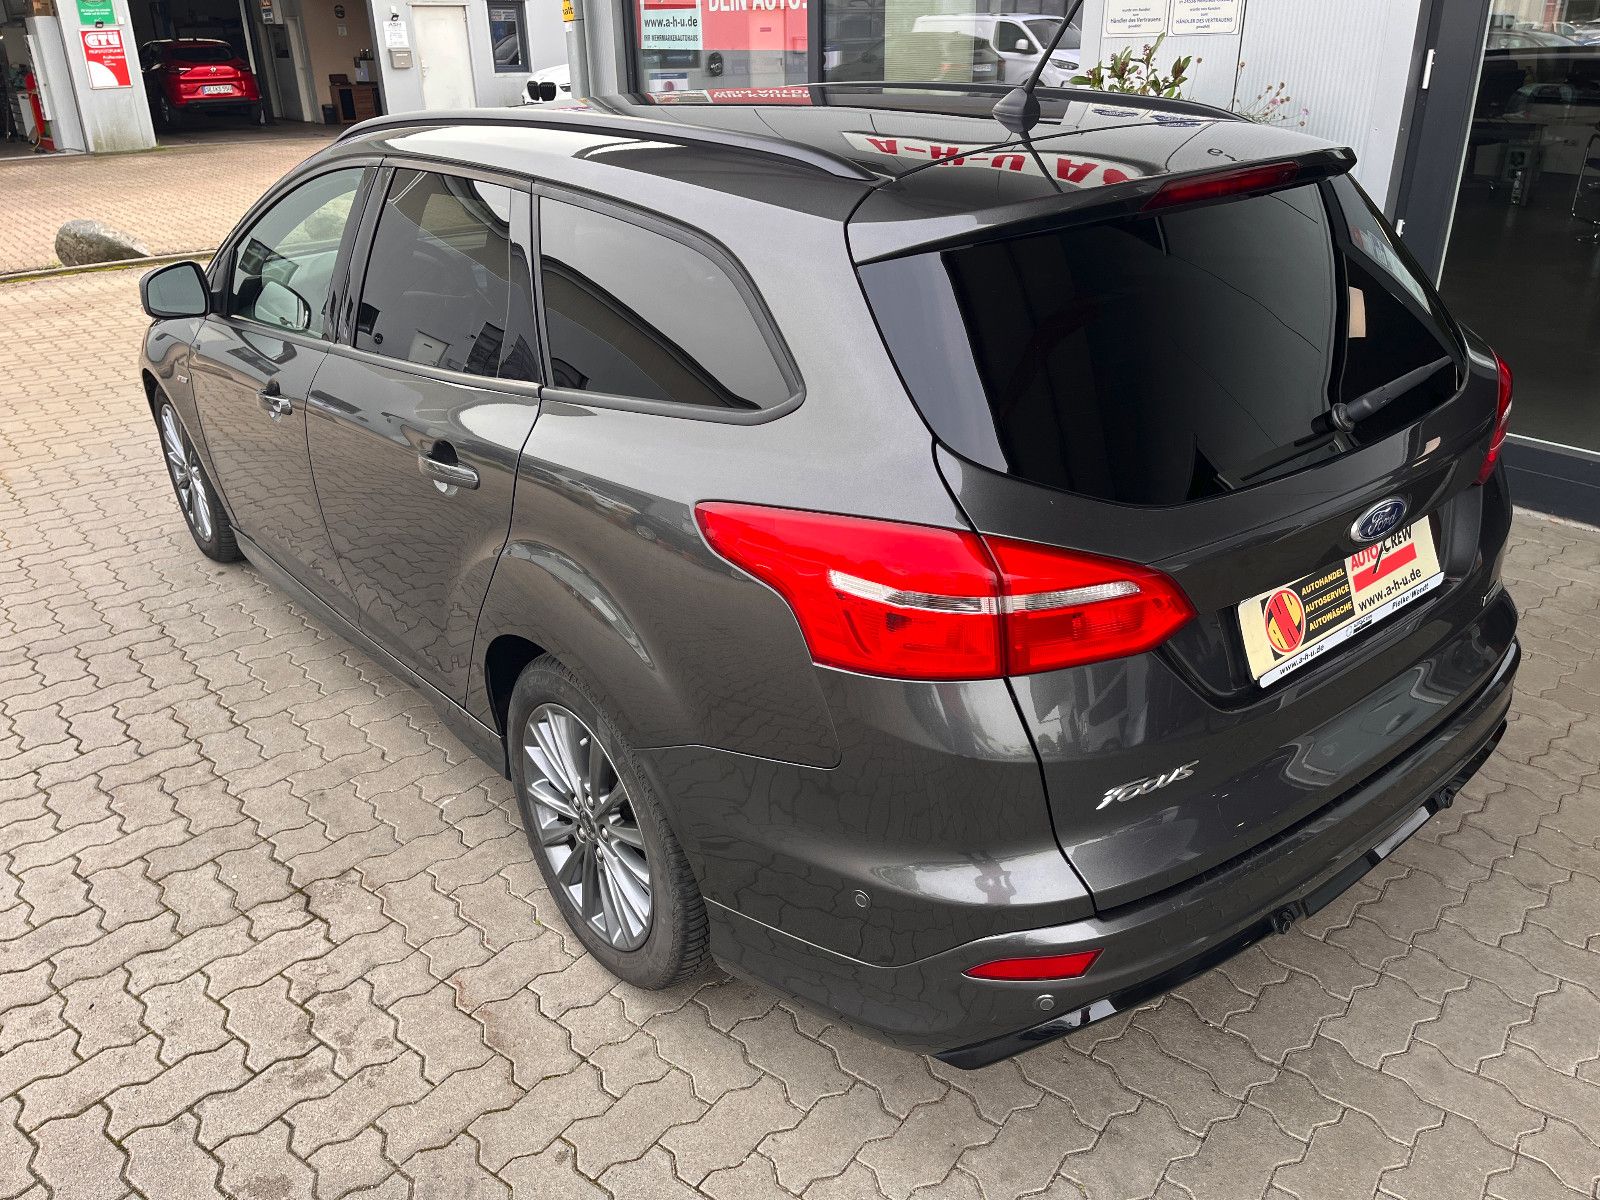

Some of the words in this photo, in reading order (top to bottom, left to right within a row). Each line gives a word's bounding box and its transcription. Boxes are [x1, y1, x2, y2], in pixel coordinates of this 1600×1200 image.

[644, 16, 698, 27] www.a-h-u.de
[85, 32, 120, 48] GTÜ
[1301, 568, 1345, 595] AUTOHANDEL
[1358, 568, 1422, 611] www.a-h-u.de
[1305, 584, 1350, 613] AUTOSERVICE
[1309, 601, 1353, 631] AUTOWÄSCHE
[1280, 645, 1324, 675] www.a-h-u.de
